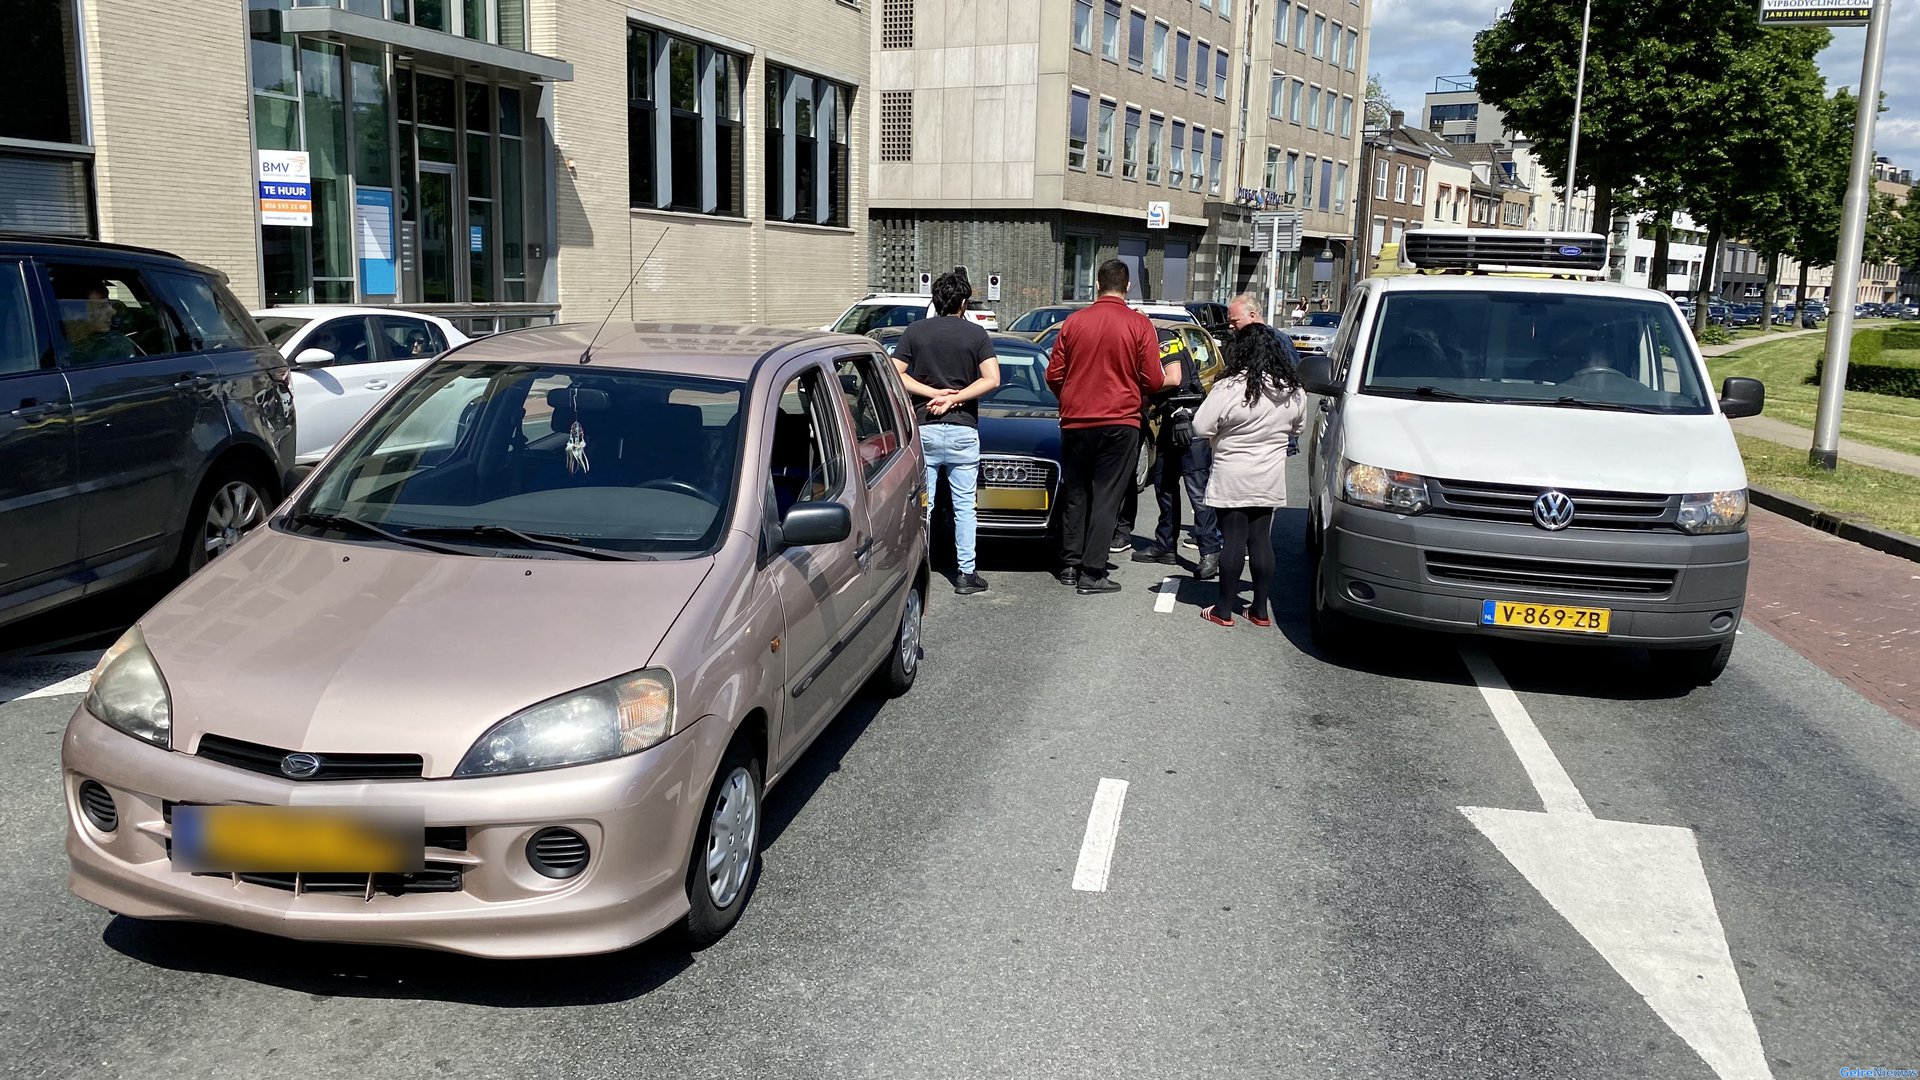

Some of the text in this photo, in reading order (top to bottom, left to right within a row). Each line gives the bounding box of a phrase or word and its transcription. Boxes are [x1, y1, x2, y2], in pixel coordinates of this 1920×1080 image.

[1765, 9, 1869, 18] JANSBINNENSINGEL 16
[262, 162, 290, 173] BMV
[263, 186, 307, 196] TE HUUR
[1503, 605, 1601, 629] V-869-ZB
